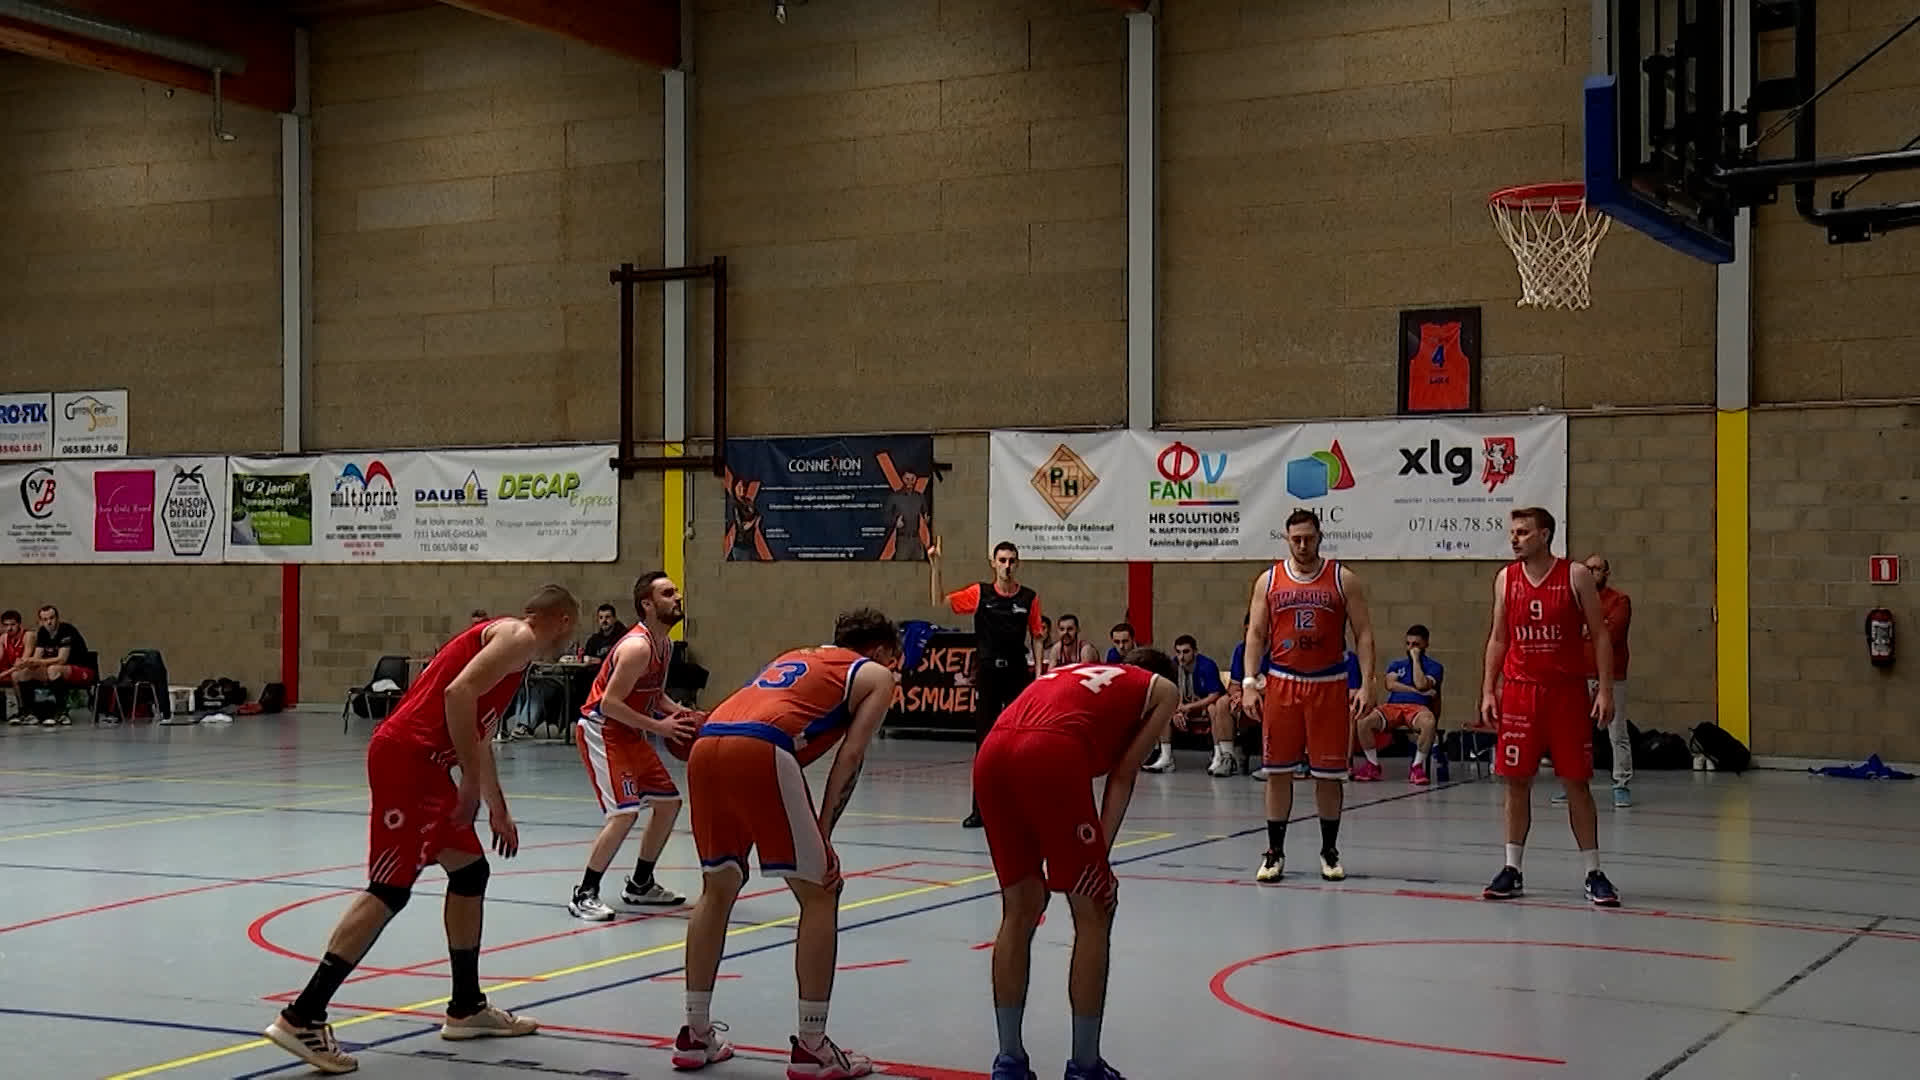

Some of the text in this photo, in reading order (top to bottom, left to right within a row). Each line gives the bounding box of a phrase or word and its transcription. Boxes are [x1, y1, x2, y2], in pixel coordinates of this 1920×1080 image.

[1432, 344, 1444, 367] 4
[788, 456, 862, 473] CONNEXION
[1398, 438, 1473, 486] xlg
[497, 472, 580, 500] DECAP
[1150, 481, 1192, 499] FAN
[169, 497, 207, 509] MAISON
[1149, 512, 1240, 524] HR SOLUTIONS
[1408, 516, 1504, 533] 071/48.78.58
[1435, 539, 1470, 551] xlg.eu
[1296, 610, 1315, 629] 12
[1529, 600, 1543, 621] 9
[889, 685, 976, 713] ASMUEL
[1504, 744, 1520, 766] 9
